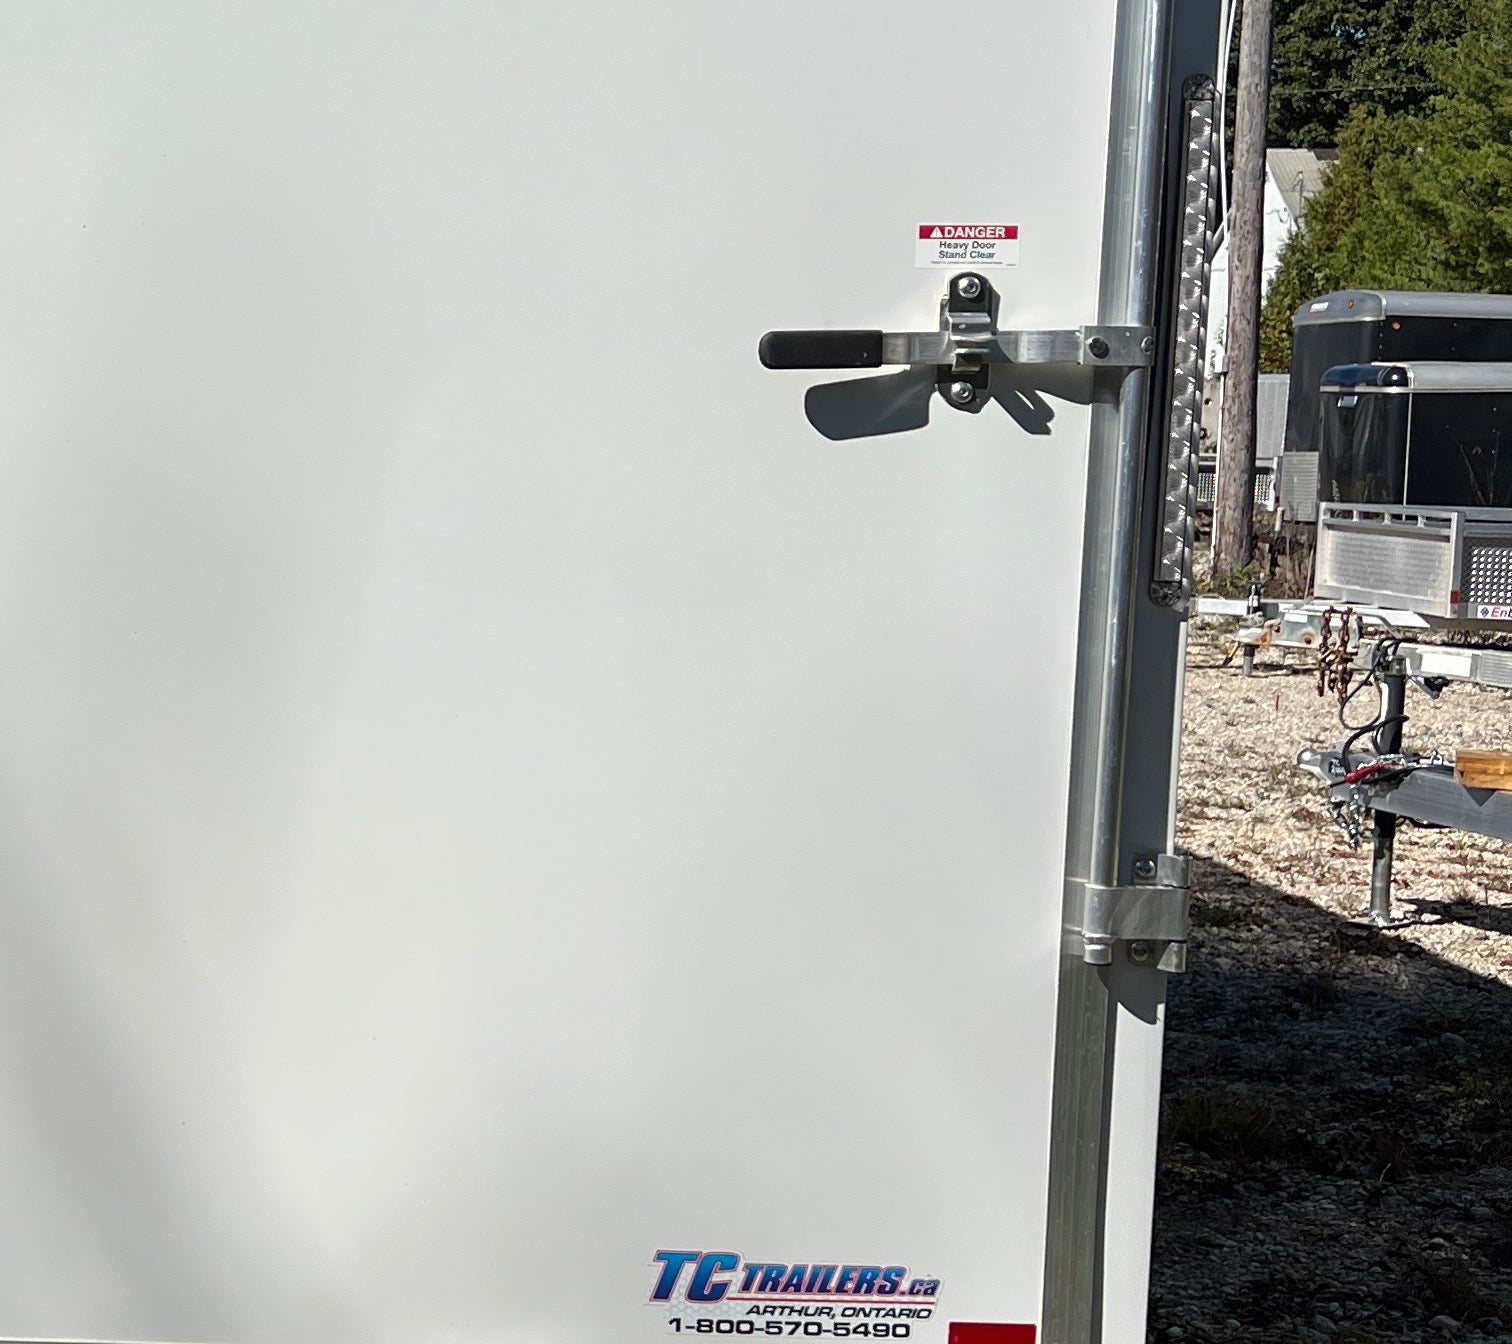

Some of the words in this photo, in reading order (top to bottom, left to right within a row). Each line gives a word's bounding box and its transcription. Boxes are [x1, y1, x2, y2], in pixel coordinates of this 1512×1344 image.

[944, 226, 1006, 238] DANGER
[939, 241, 969, 250] Heavy
[971, 241, 996, 249] Door
[938, 250, 967, 259] Stand
[969, 250, 996, 259] Clear
[649, 1249, 741, 1304] TC
[737, 1262, 940, 1296] TRAILERS.ca
[745, 1305, 837, 1320] ARTHUR,
[841, 1307, 933, 1320] ONTARIO
[668, 1317, 911, 1339] 1-800-570-5490
